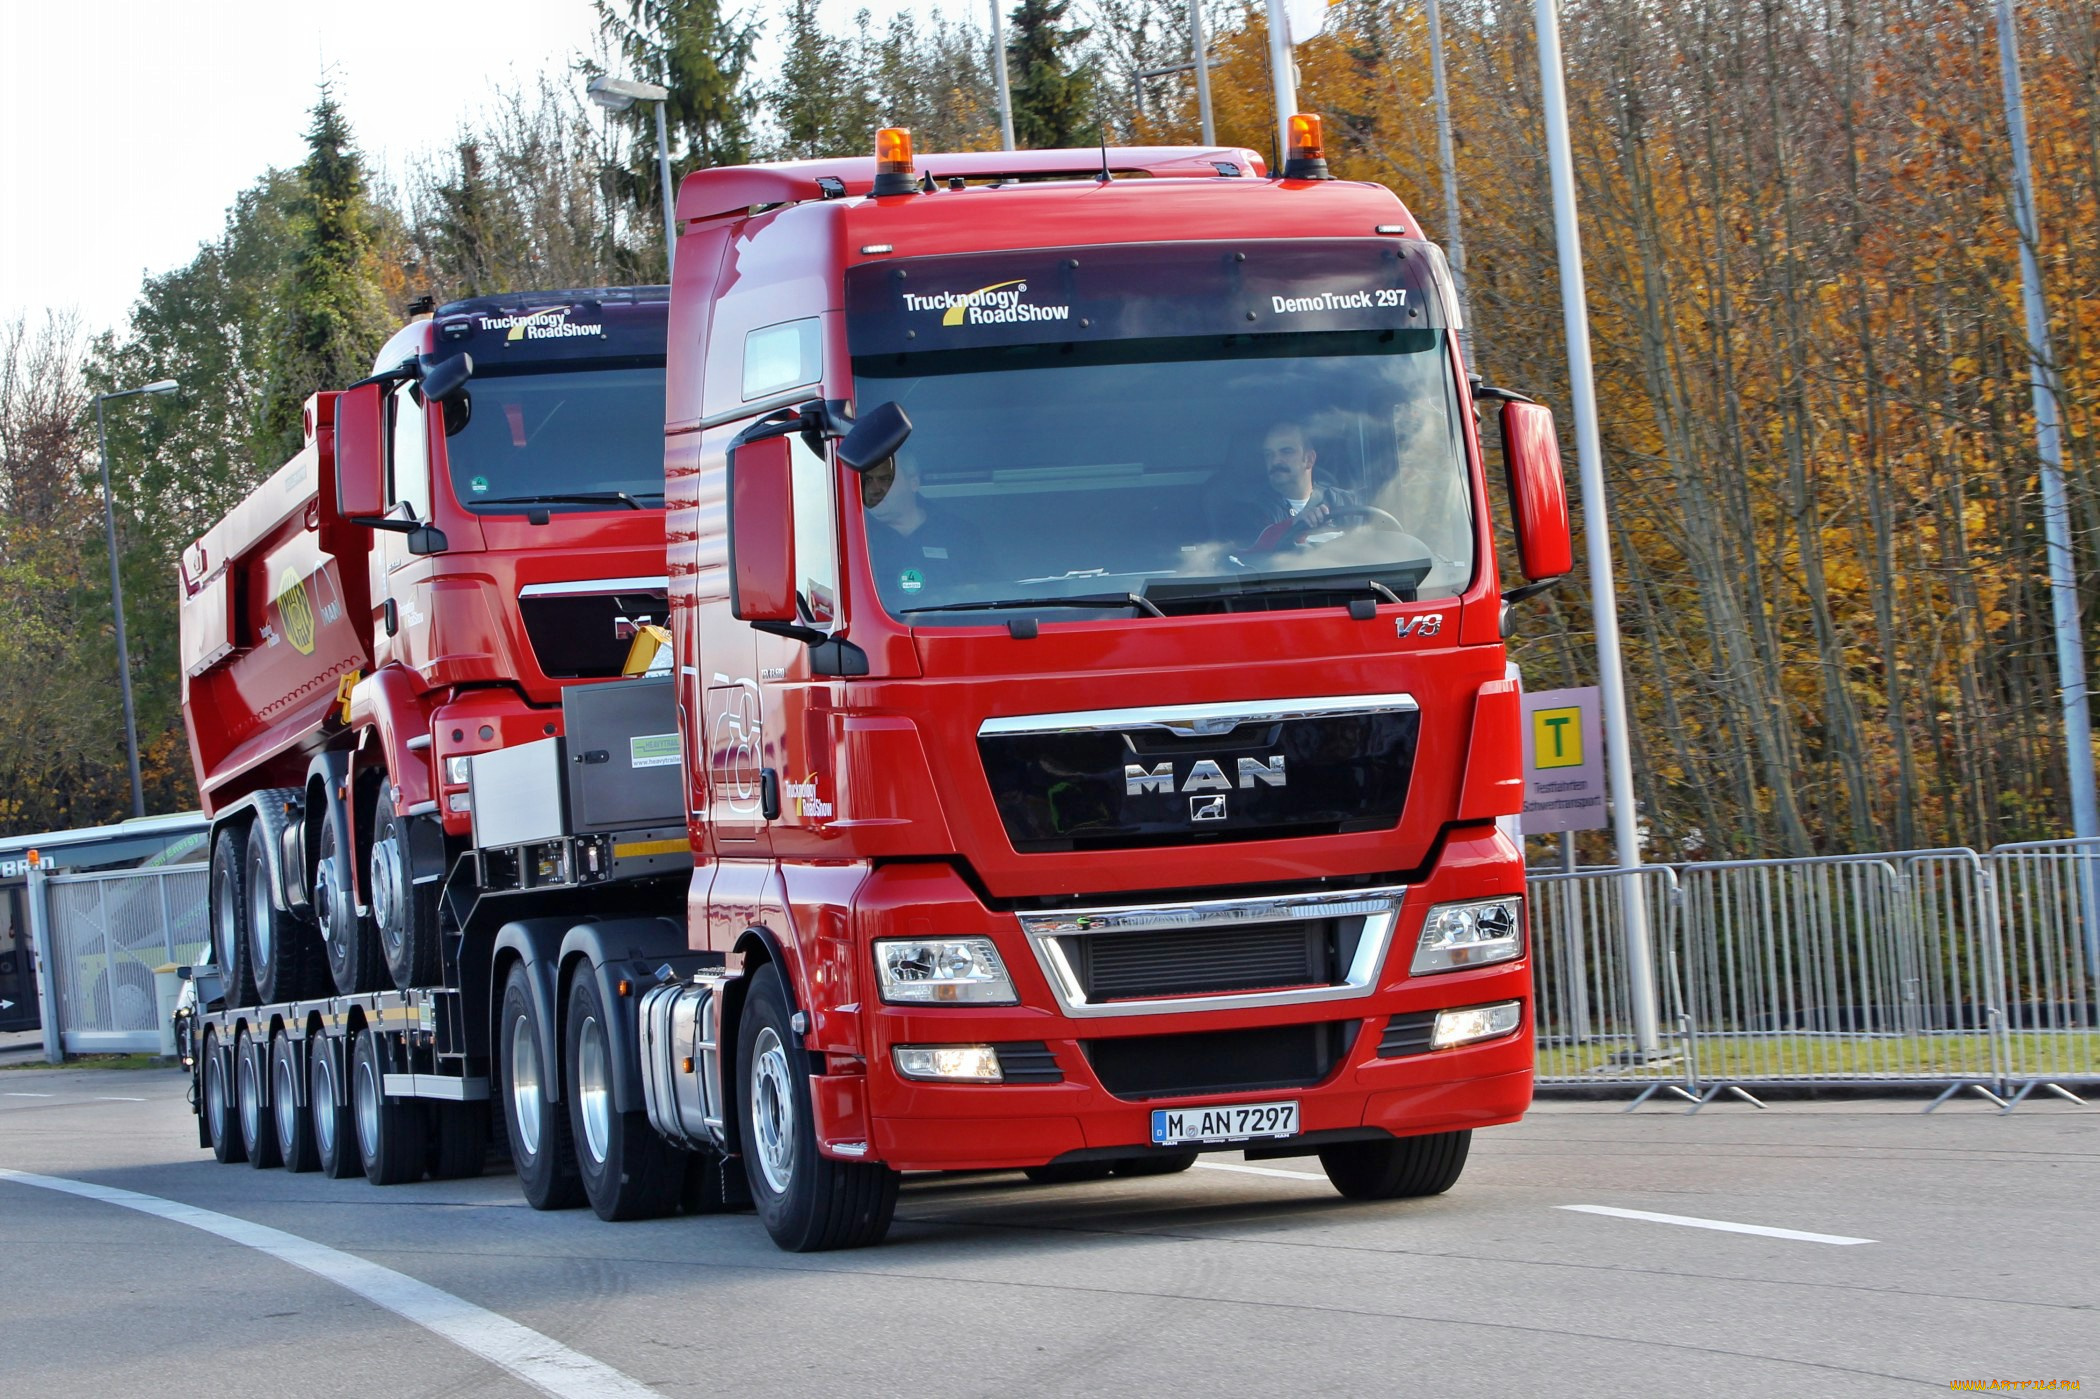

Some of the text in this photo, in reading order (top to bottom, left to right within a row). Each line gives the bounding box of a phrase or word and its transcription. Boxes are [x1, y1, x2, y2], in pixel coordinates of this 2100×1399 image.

[1272, 289, 1407, 313] DemoTruck 297
[969, 304, 1069, 325] RoadShow
[527, 322, 601, 340] RoadShow
[1395, 613, 1443, 638] V8
[1544, 717, 1571, 757] T
[1125, 755, 1286, 796] MAN
[802, 798, 833, 817] RoadShow
[166, 833, 200, 857] Energy
[1156, 1106, 1294, 1137] D M AN 7297
